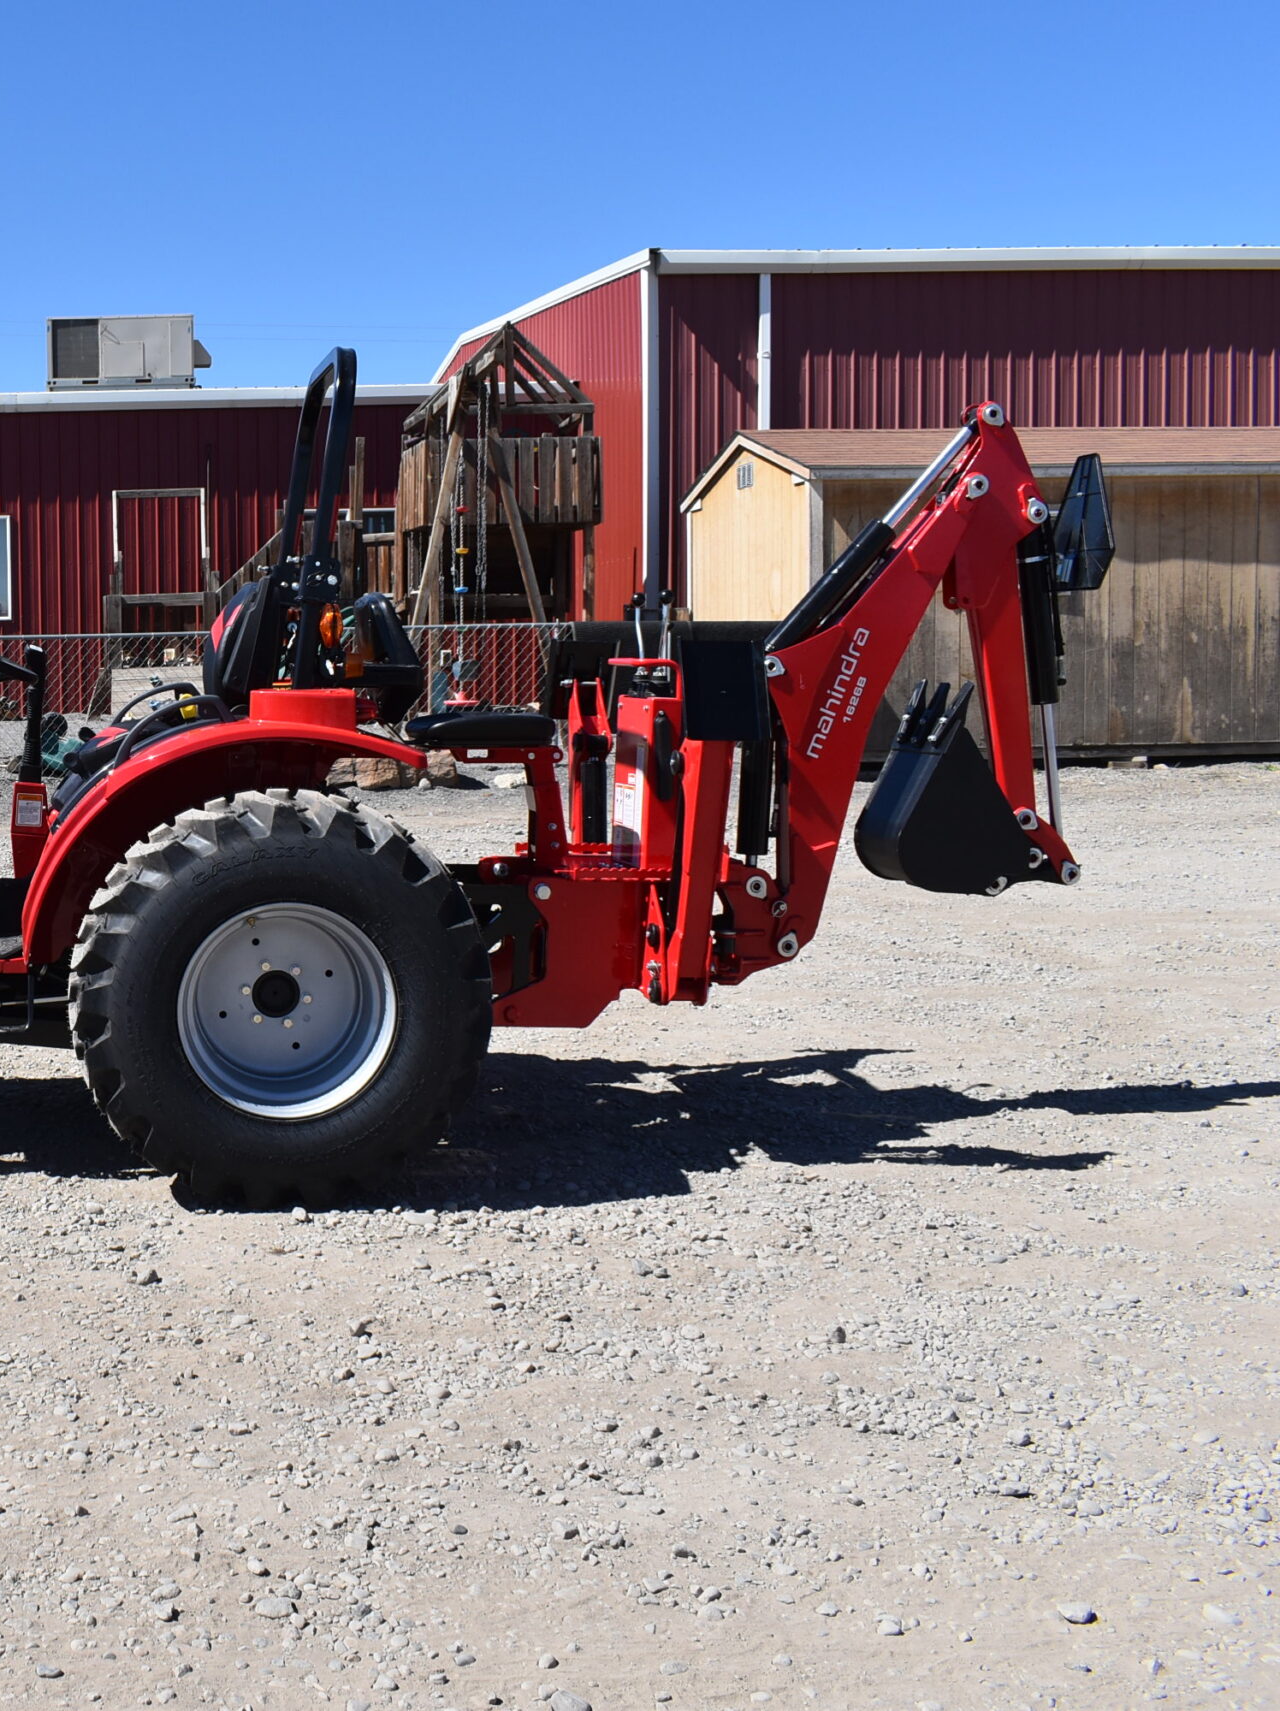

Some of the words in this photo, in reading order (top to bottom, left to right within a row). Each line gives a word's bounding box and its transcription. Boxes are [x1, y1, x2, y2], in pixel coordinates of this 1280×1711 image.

[806, 627, 870, 759] mahindra
[842, 676, 867, 723] 1626B
[192, 846, 319, 887] GALAXY
